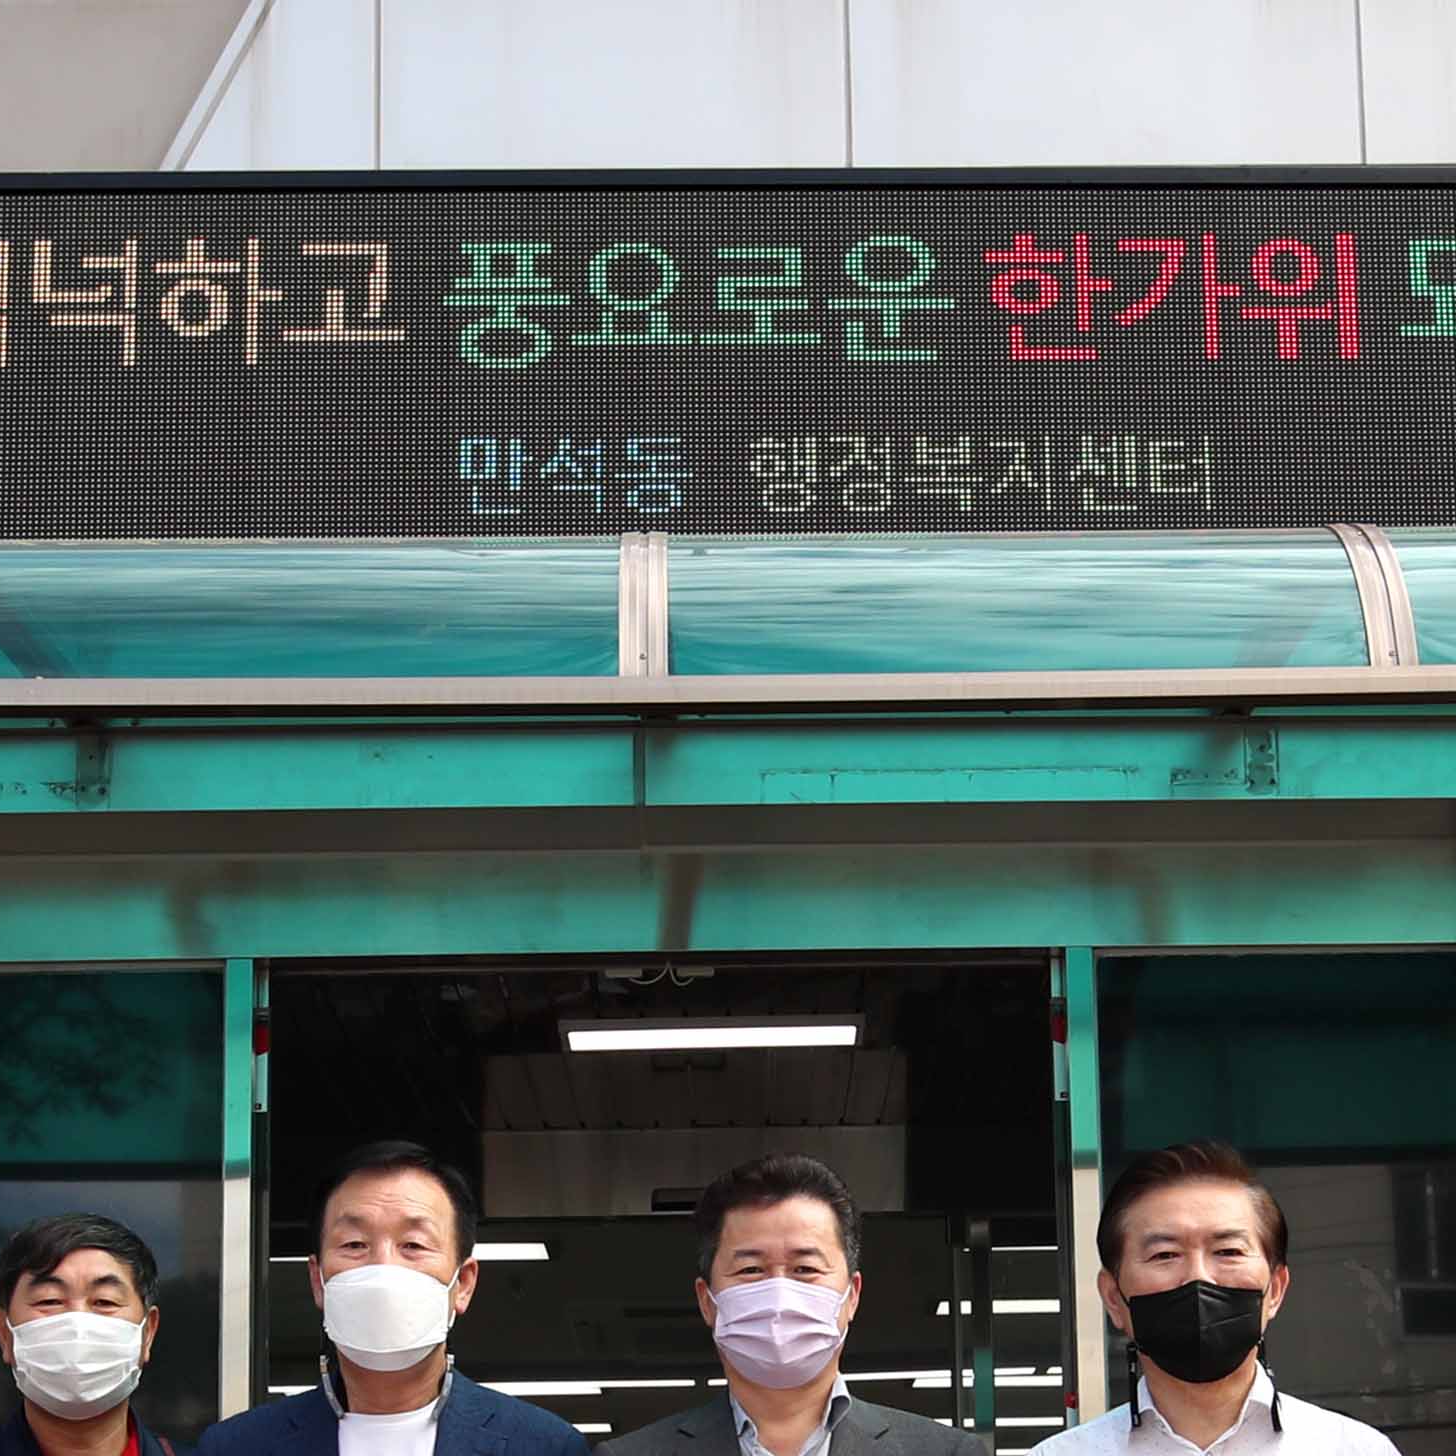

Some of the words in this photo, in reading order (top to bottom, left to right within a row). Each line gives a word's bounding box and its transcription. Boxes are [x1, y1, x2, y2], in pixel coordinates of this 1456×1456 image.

[443, 234, 955, 369] 풍요로운
[982, 232, 1360, 360] 한가위
[458, 436, 693, 515] 만석동
[749, 433, 1213, 514] 행정복지센터
